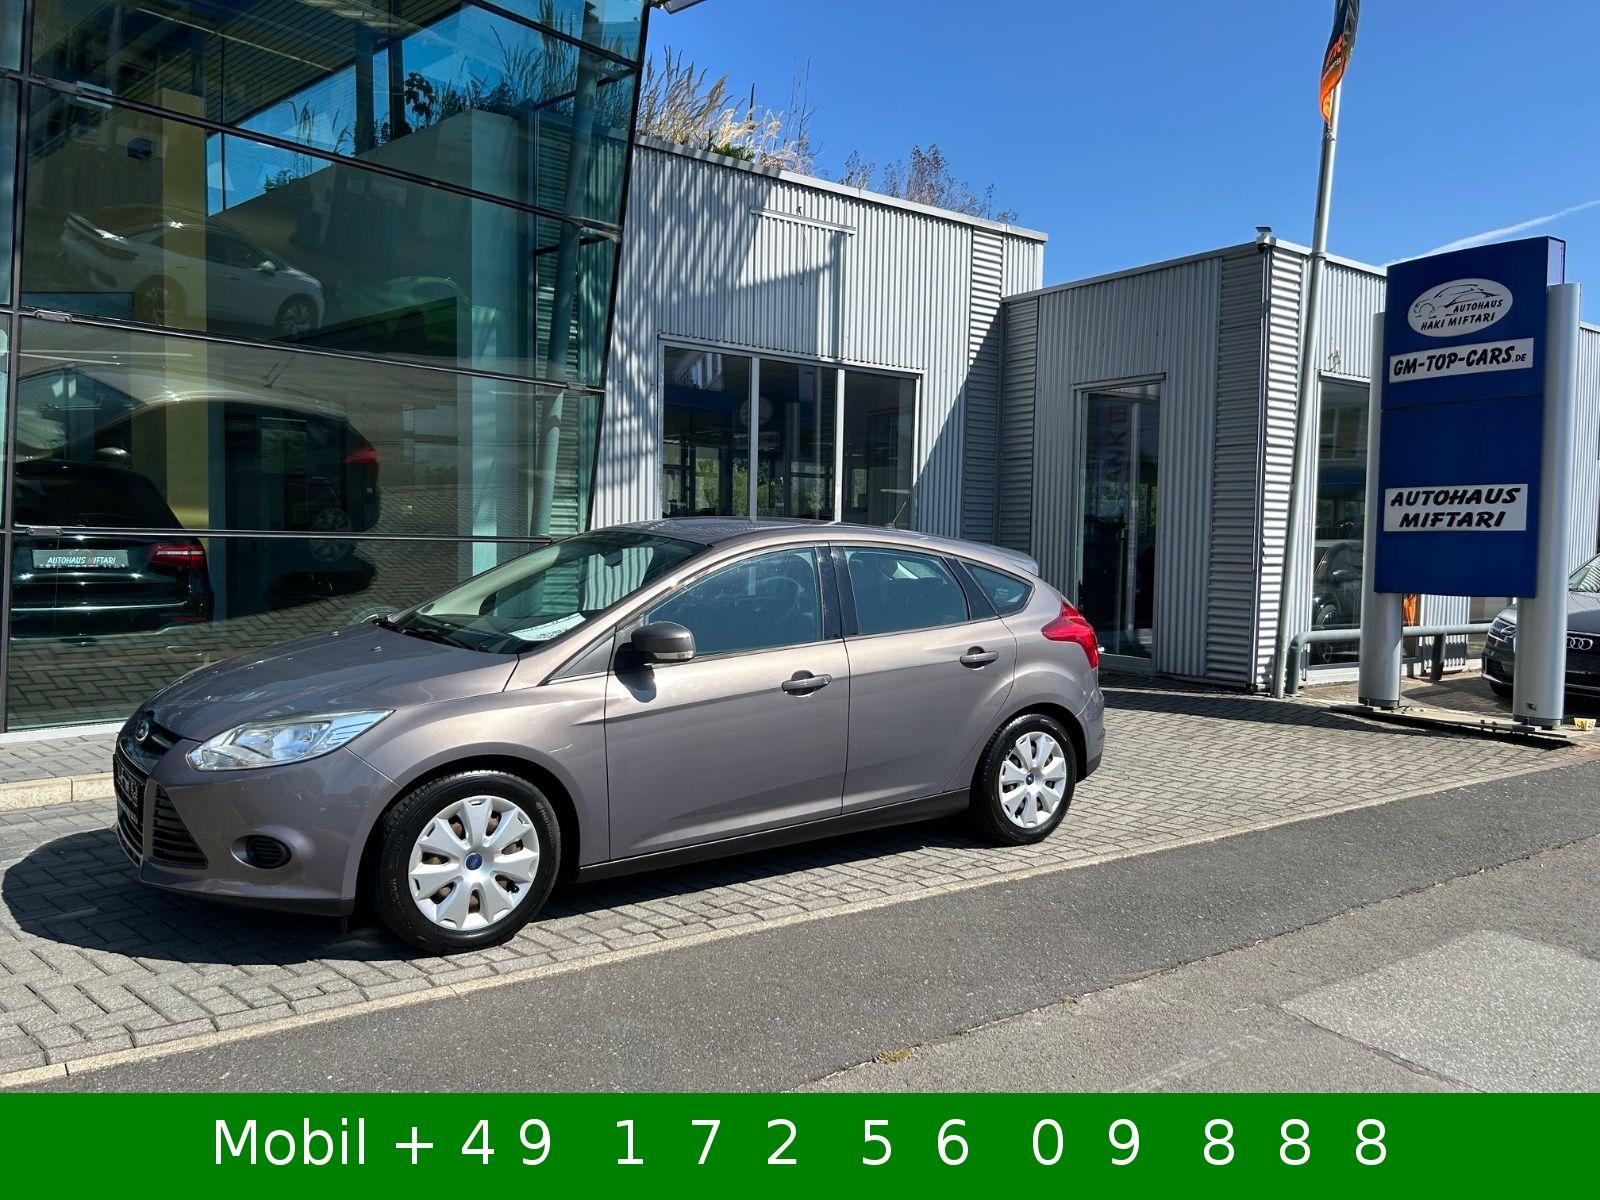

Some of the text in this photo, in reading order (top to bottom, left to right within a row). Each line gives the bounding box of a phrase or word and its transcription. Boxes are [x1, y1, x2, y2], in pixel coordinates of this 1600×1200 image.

[1452, 299, 1504, 314] AUTOHAUS
[1420, 312, 1496, 331] HAKI MIFTARI
[1393, 345, 1528, 377] GM-TOP-CARS.DE
[1390, 487, 1521, 507] AUTOHAUS
[1399, 511, 1507, 528] MIFTARI
[47, 556, 86, 564] AUTOHAUS
